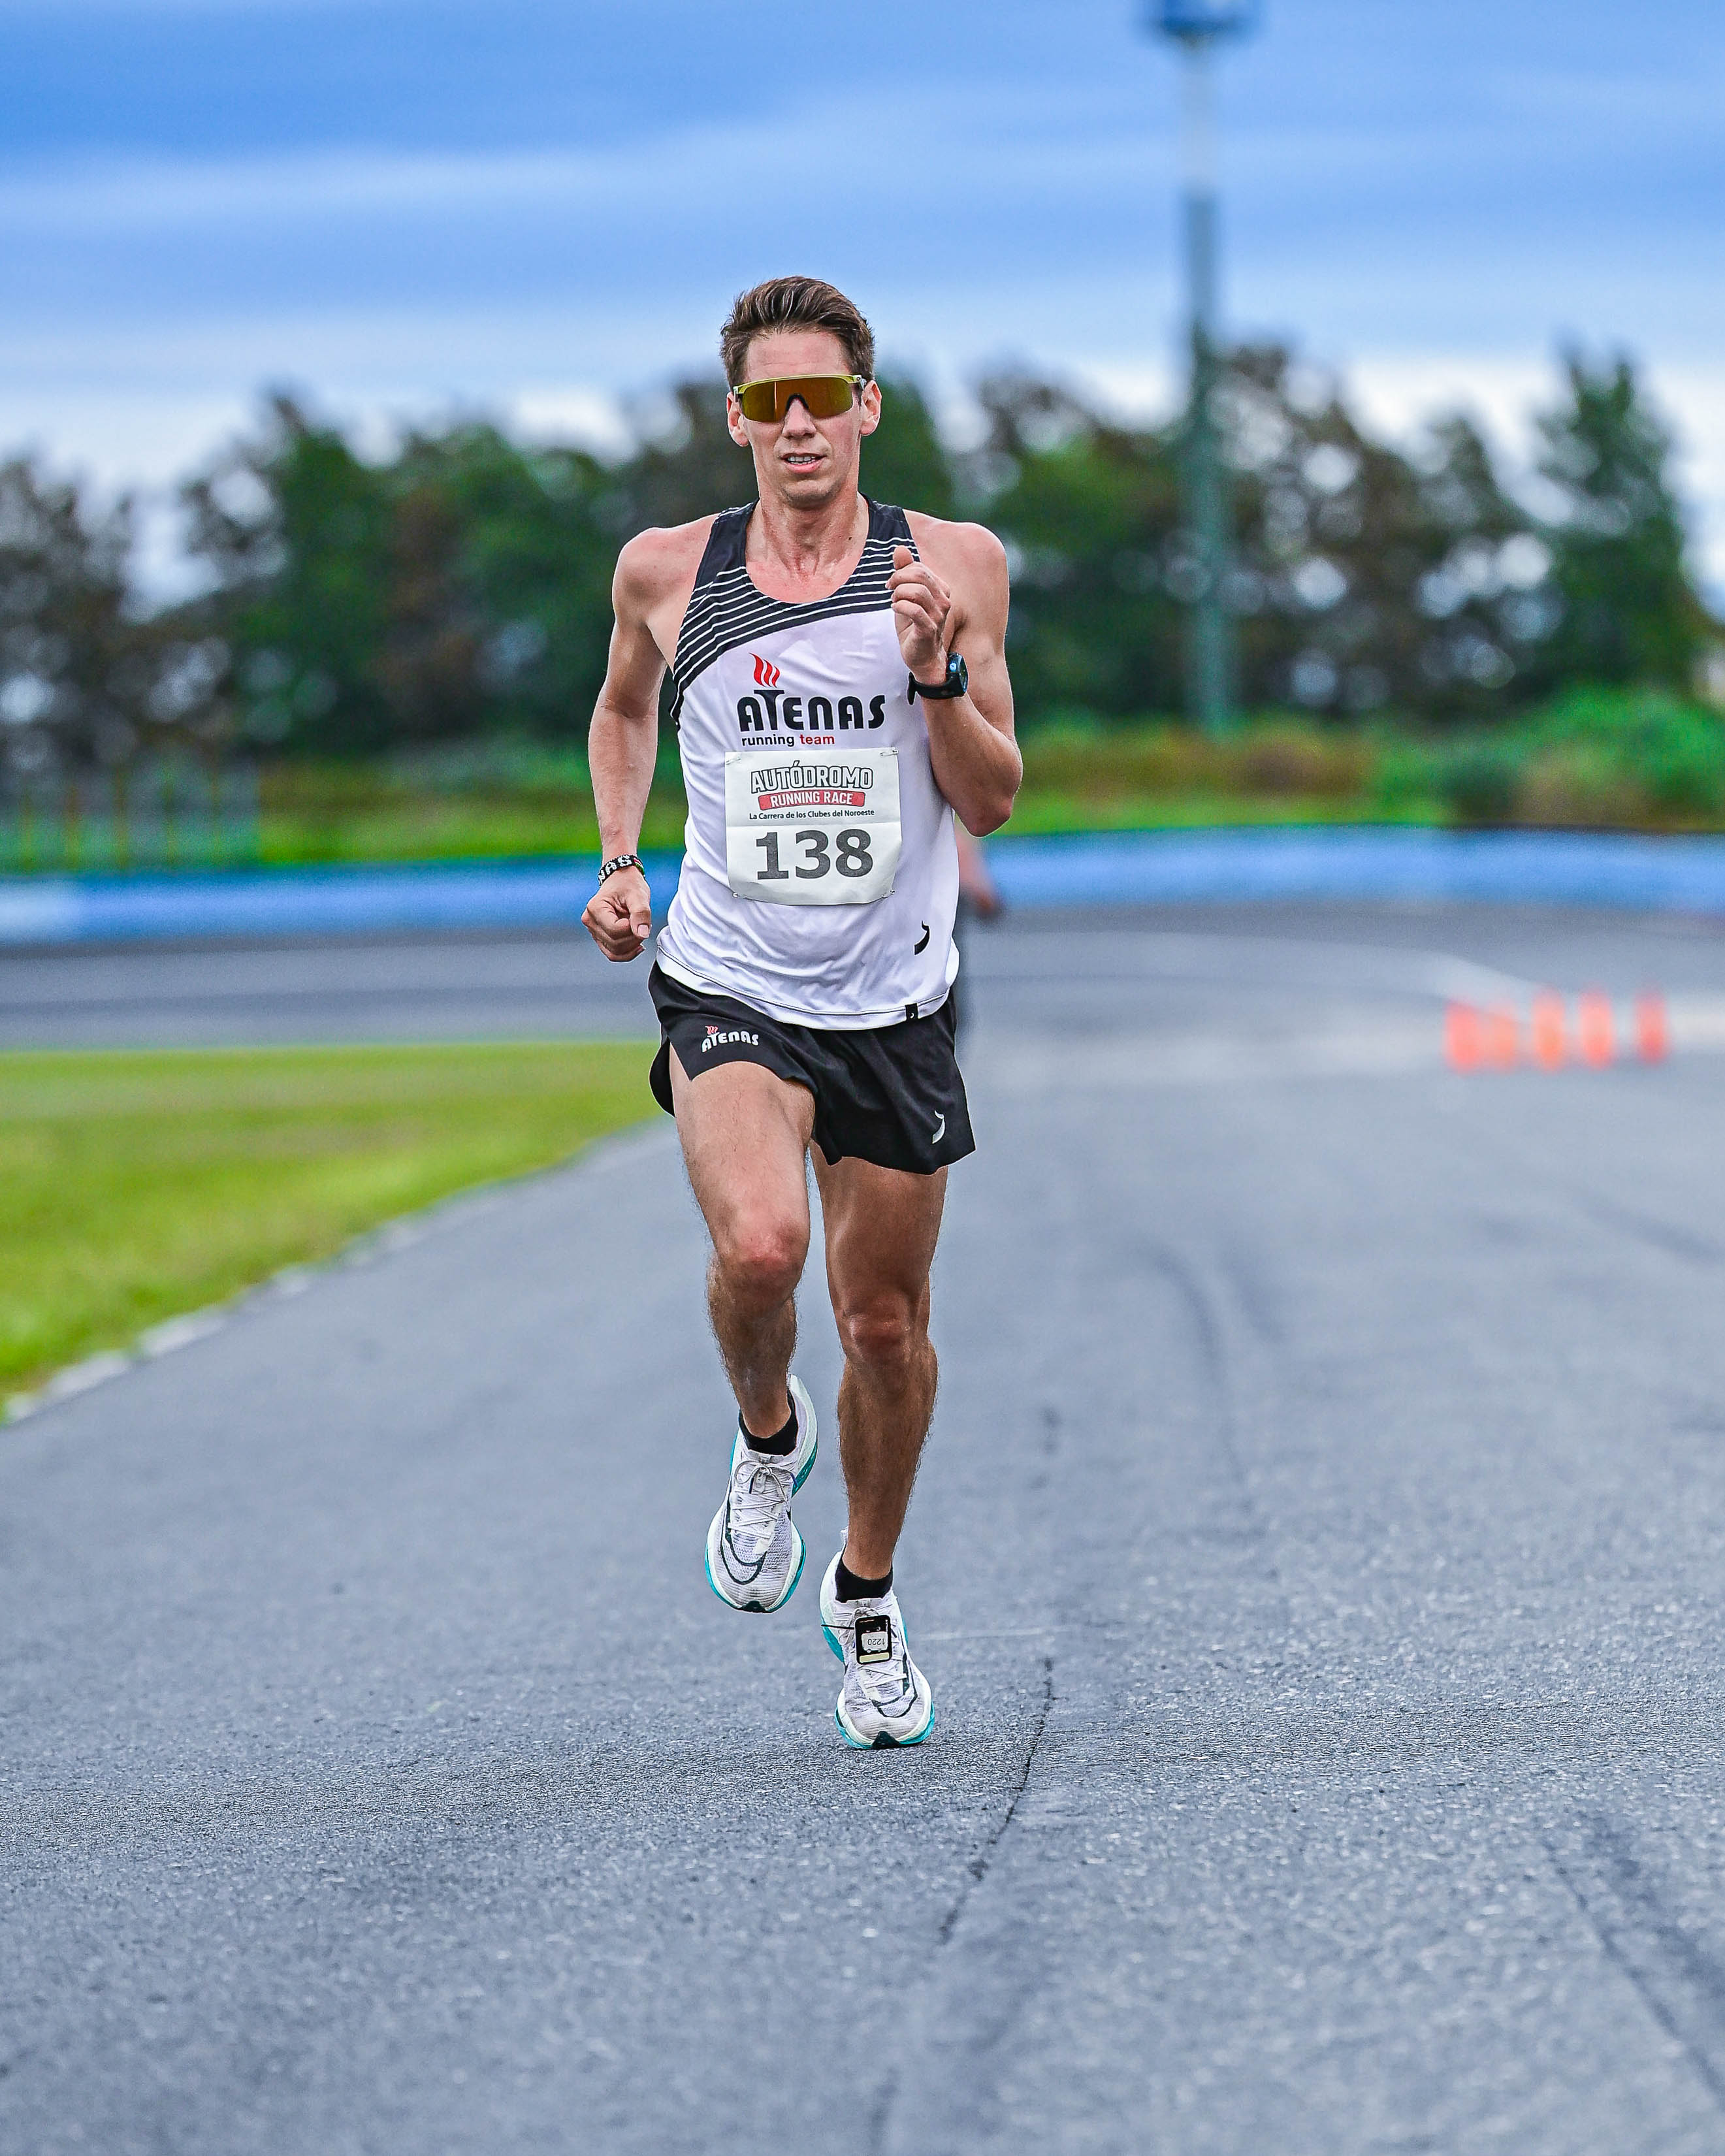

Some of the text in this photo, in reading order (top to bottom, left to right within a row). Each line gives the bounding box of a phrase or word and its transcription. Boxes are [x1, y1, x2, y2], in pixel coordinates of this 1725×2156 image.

[737, 690, 886, 732] ATENAS
[742, 733, 835, 747] running team
[751, 760, 874, 794] AUTÓDROMO
[770, 792, 853, 807] RUNNING RACE
[598, 854, 632, 886] NAS
[756, 829, 873, 880] 138
[701, 1031, 759, 1053] ATENAS
